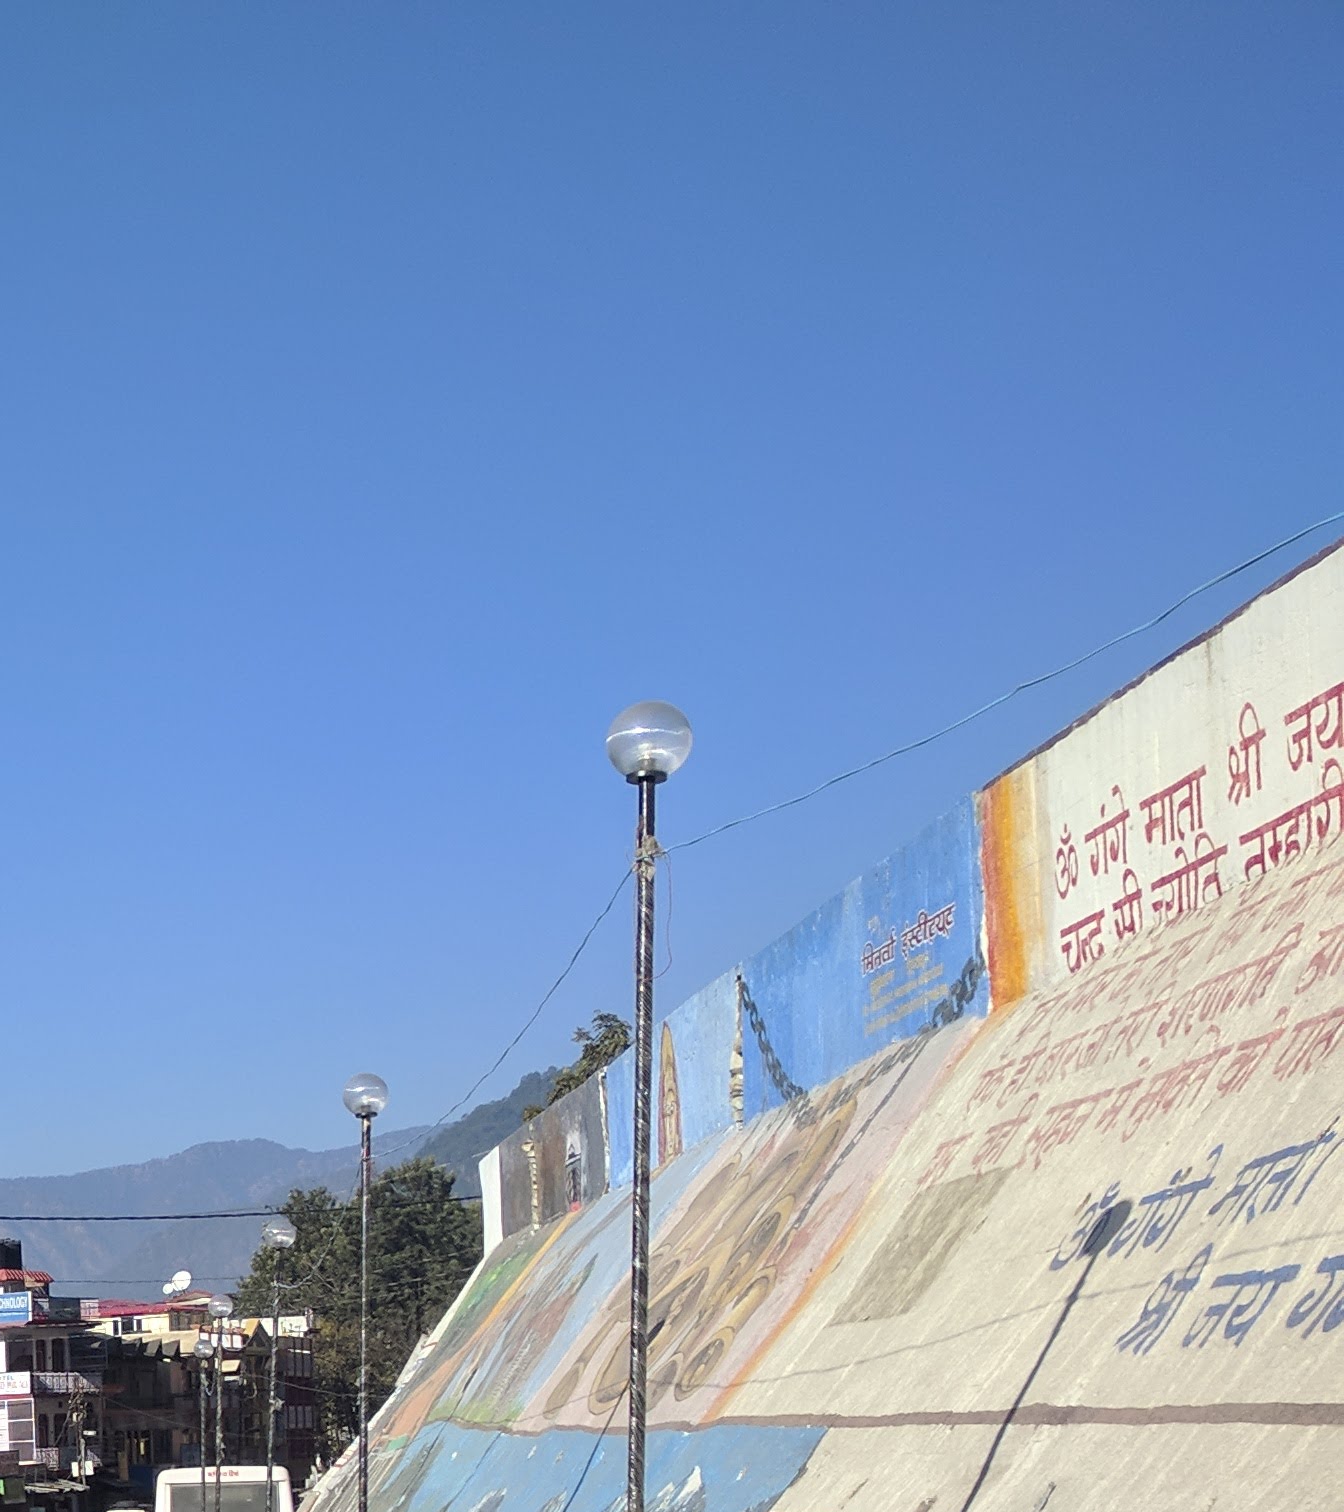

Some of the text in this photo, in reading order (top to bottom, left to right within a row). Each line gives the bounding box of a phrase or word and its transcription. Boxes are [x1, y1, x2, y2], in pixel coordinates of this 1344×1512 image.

[1085, 785, 1129, 876] गंगे
[1139, 764, 1206, 845] माता
[1228, 702, 1266, 805] श्री
[1114, 1242, 1213, 1355] श्री
[1182, 1264, 1301, 1348] जय
